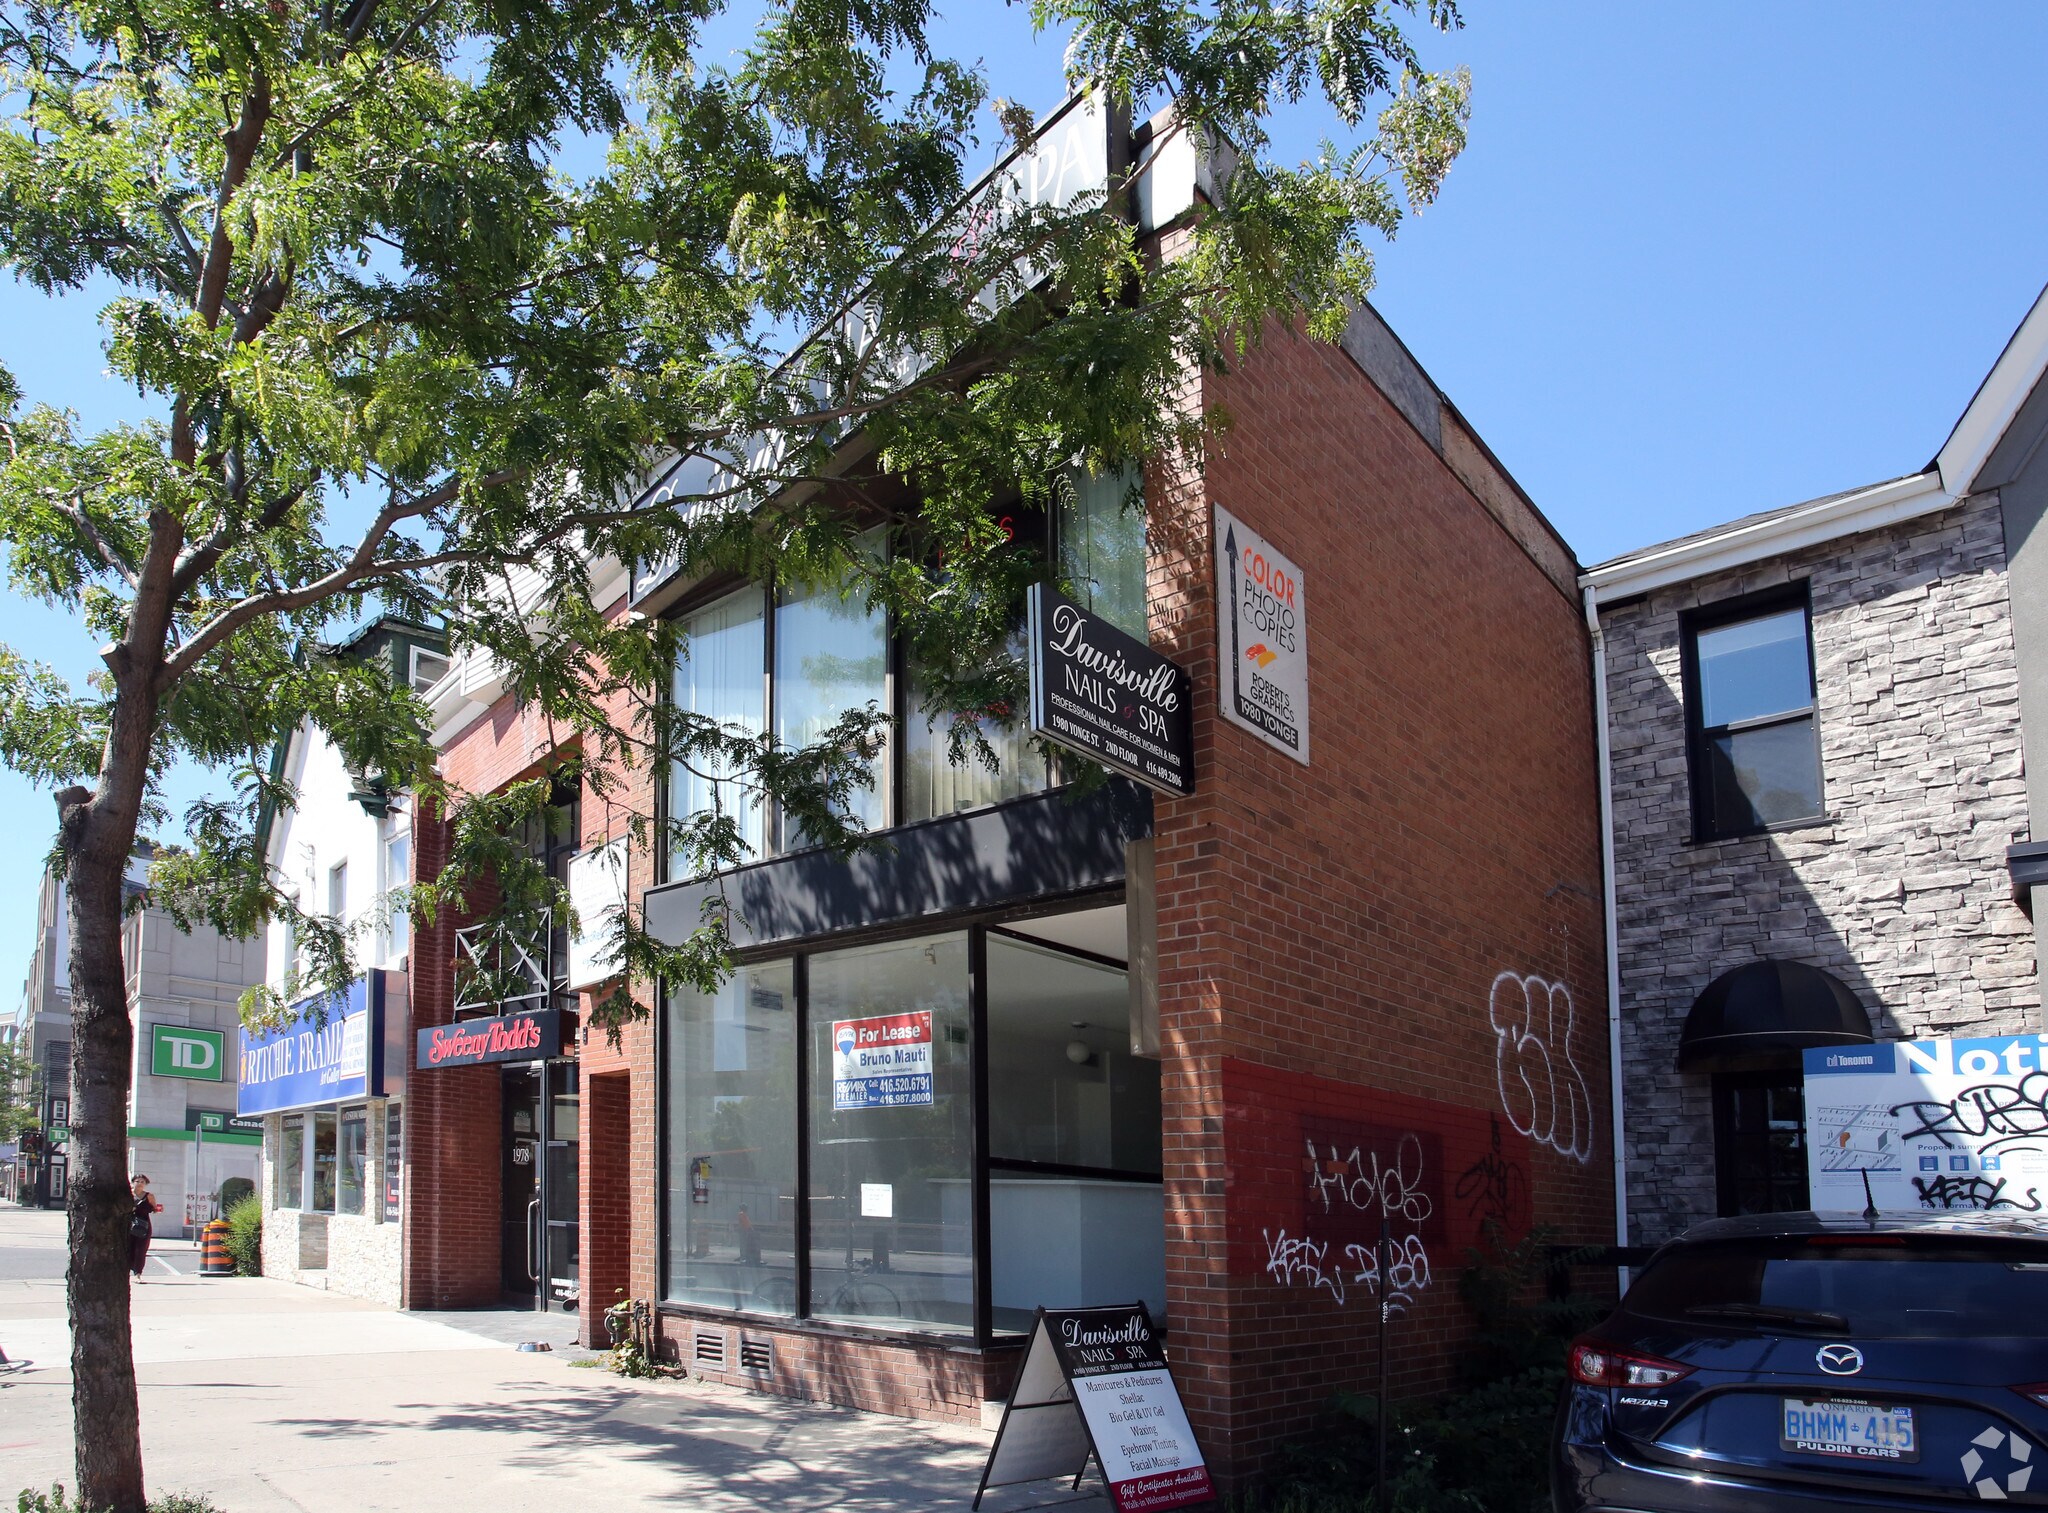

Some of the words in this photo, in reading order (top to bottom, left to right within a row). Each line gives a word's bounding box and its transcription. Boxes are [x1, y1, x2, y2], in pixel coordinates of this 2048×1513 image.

[1243, 547, 1295, 610] COLOR
[1245, 579, 1295, 630] PHOTO
[1243, 601, 1295, 653] COPIES
[1049, 604, 1178, 713] Davisville
[1252, 672, 1290, 707] ROBERTS
[1065, 663, 1117, 714] NAILS
[1139, 704, 1168, 742] SPA
[1250, 686, 1295, 722] GRAPHICS
[1051, 692, 1098, 724] PROFESSIONAL
[1099, 717, 1111, 731] NAIL
[1113, 724, 1128, 738] CARE
[1130, 732, 1141, 744] FOR
[1142, 738, 1163, 755] WOMEN
[1168, 752, 1180, 765] MEN
[1240, 698, 1260, 722] 1980
[1262, 711, 1296, 745] YONGE
[1052, 714, 1068, 732] 1980
[1069, 722, 1090, 744] YONGE
[1091, 733, 1099, 747] ST.
[1105, 740, 1118, 756] 2ND
[1119, 747, 1138, 766] FLOOR
[1146, 761, 1157, 775] 416
[429, 1028, 490, 1064] Sweeny
[489, 1017, 541, 1052] Todd's
[859, 1027, 880, 1043] For
[882, 1025, 921, 1040] Lease
[161, 1036, 215, 1069] TD
[247, 1037, 295, 1085] RITCHIE
[860, 1053, 890, 1066] Bruno
[895, 1048, 926, 1064] Mauti
[1838, 1055, 1873, 1066] TORONTO
[880, 1076, 930, 1093] 416.520.6791
[836, 1092, 867, 1101] PREMIER
[880, 1093, 930, 1104] 416.987.8000
[203, 1116, 220, 1127] TD
[513, 1148, 530, 1163] 1978
[1062, 1315, 1149, 1348] Davisville
[1081, 1347, 1115, 1364] NAILS
[1126, 1346, 1147, 1360] SPA
[1085, 1379, 1123, 1392] Manicures
[1124, 1378, 1131, 1387] &
[1131, 1375, 1163, 1387] Pedicures
[1119, 1392, 1145, 1405] Shellac
[1109, 1411, 1123, 1423] Bio
[1123, 1409, 1136, 1420] Gel
[1136, 1410, 1143, 1419] &
[1143, 1408, 1153, 1418] UV
[1153, 1405, 1165, 1416] Gel
[1821, 1402, 1875, 1414] ONTARIO
[1130, 1424, 1158, 1437] Waxing
[1786, 1409, 1847, 1442] BHMM
[1121, 1443, 1152, 1458] Eyebrow
[1152, 1439, 1178, 1450] Tinting
[1797, 1441, 1852, 1454] PULDIN
[1857, 1446, 1900, 1458] CARS
[1130, 1458, 1151, 1472] Facial
[1152, 1456, 1180, 1467] Massage
[1121, 1483, 1135, 1499] Gift
[1138, 1479, 1173, 1493] Certificates
[1175, 1470, 1203, 1485] Available
[1146, 1493, 1169, 1505] Welcome
